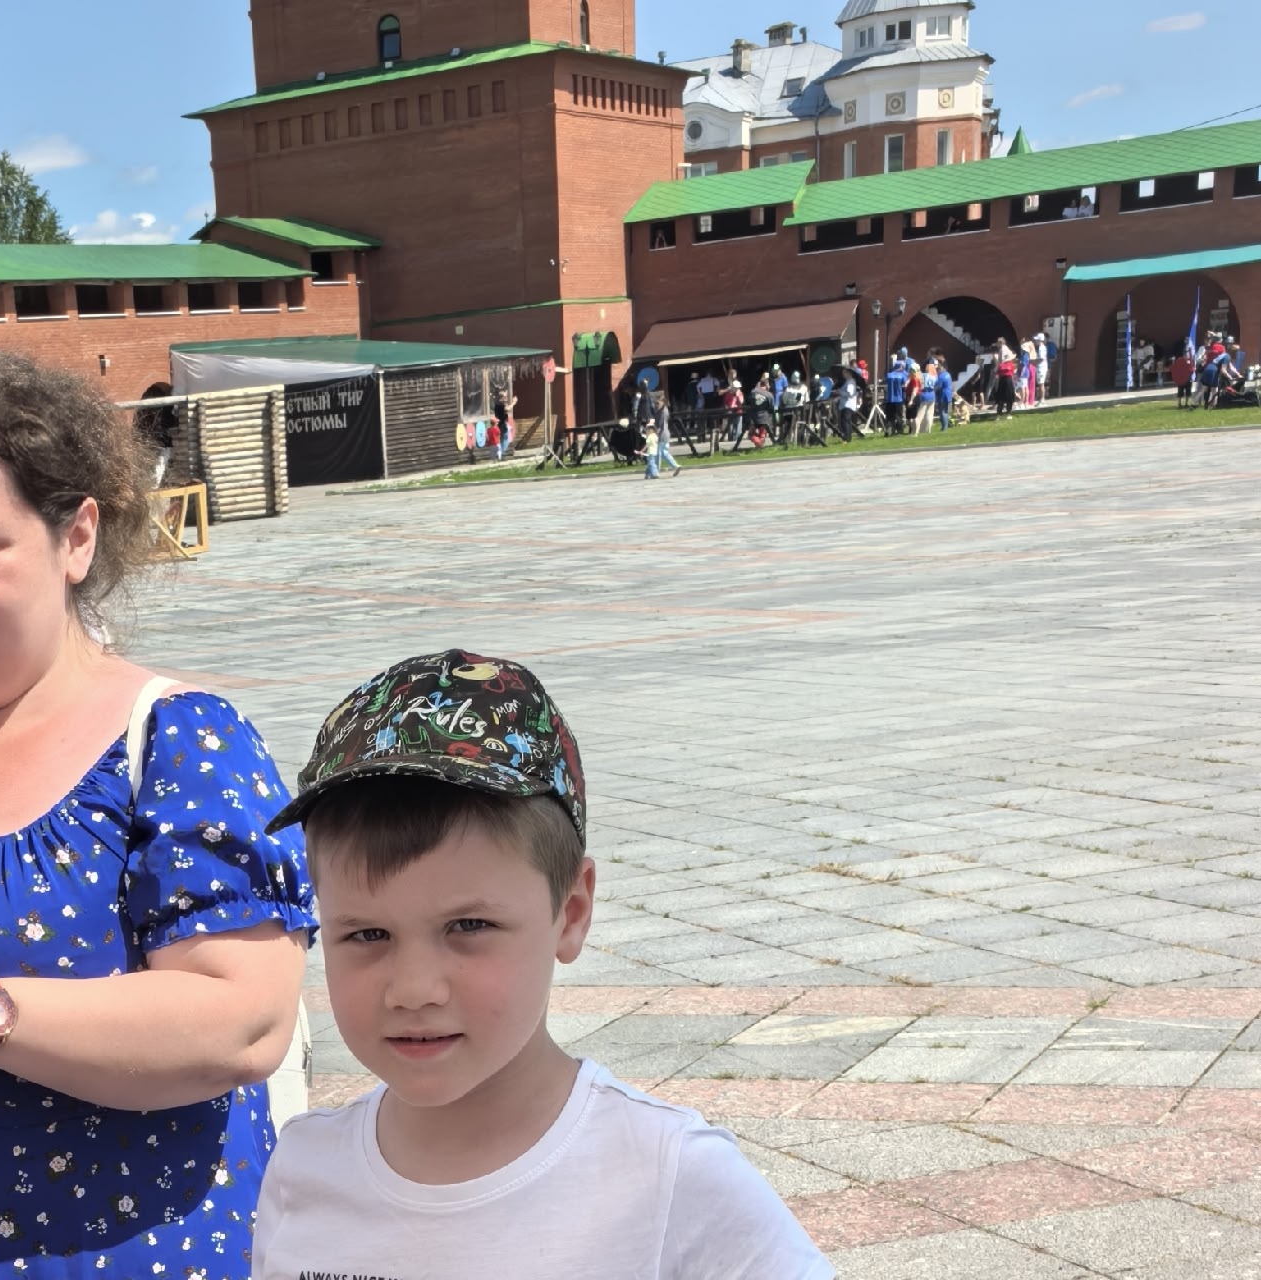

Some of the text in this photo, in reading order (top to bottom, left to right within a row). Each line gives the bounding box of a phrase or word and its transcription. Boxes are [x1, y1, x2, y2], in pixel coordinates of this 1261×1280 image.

[338, 391, 363, 406] ТИР
[286, 412, 348, 433] ОСТЮМЫ
[399, 697, 488, 740] Rules
